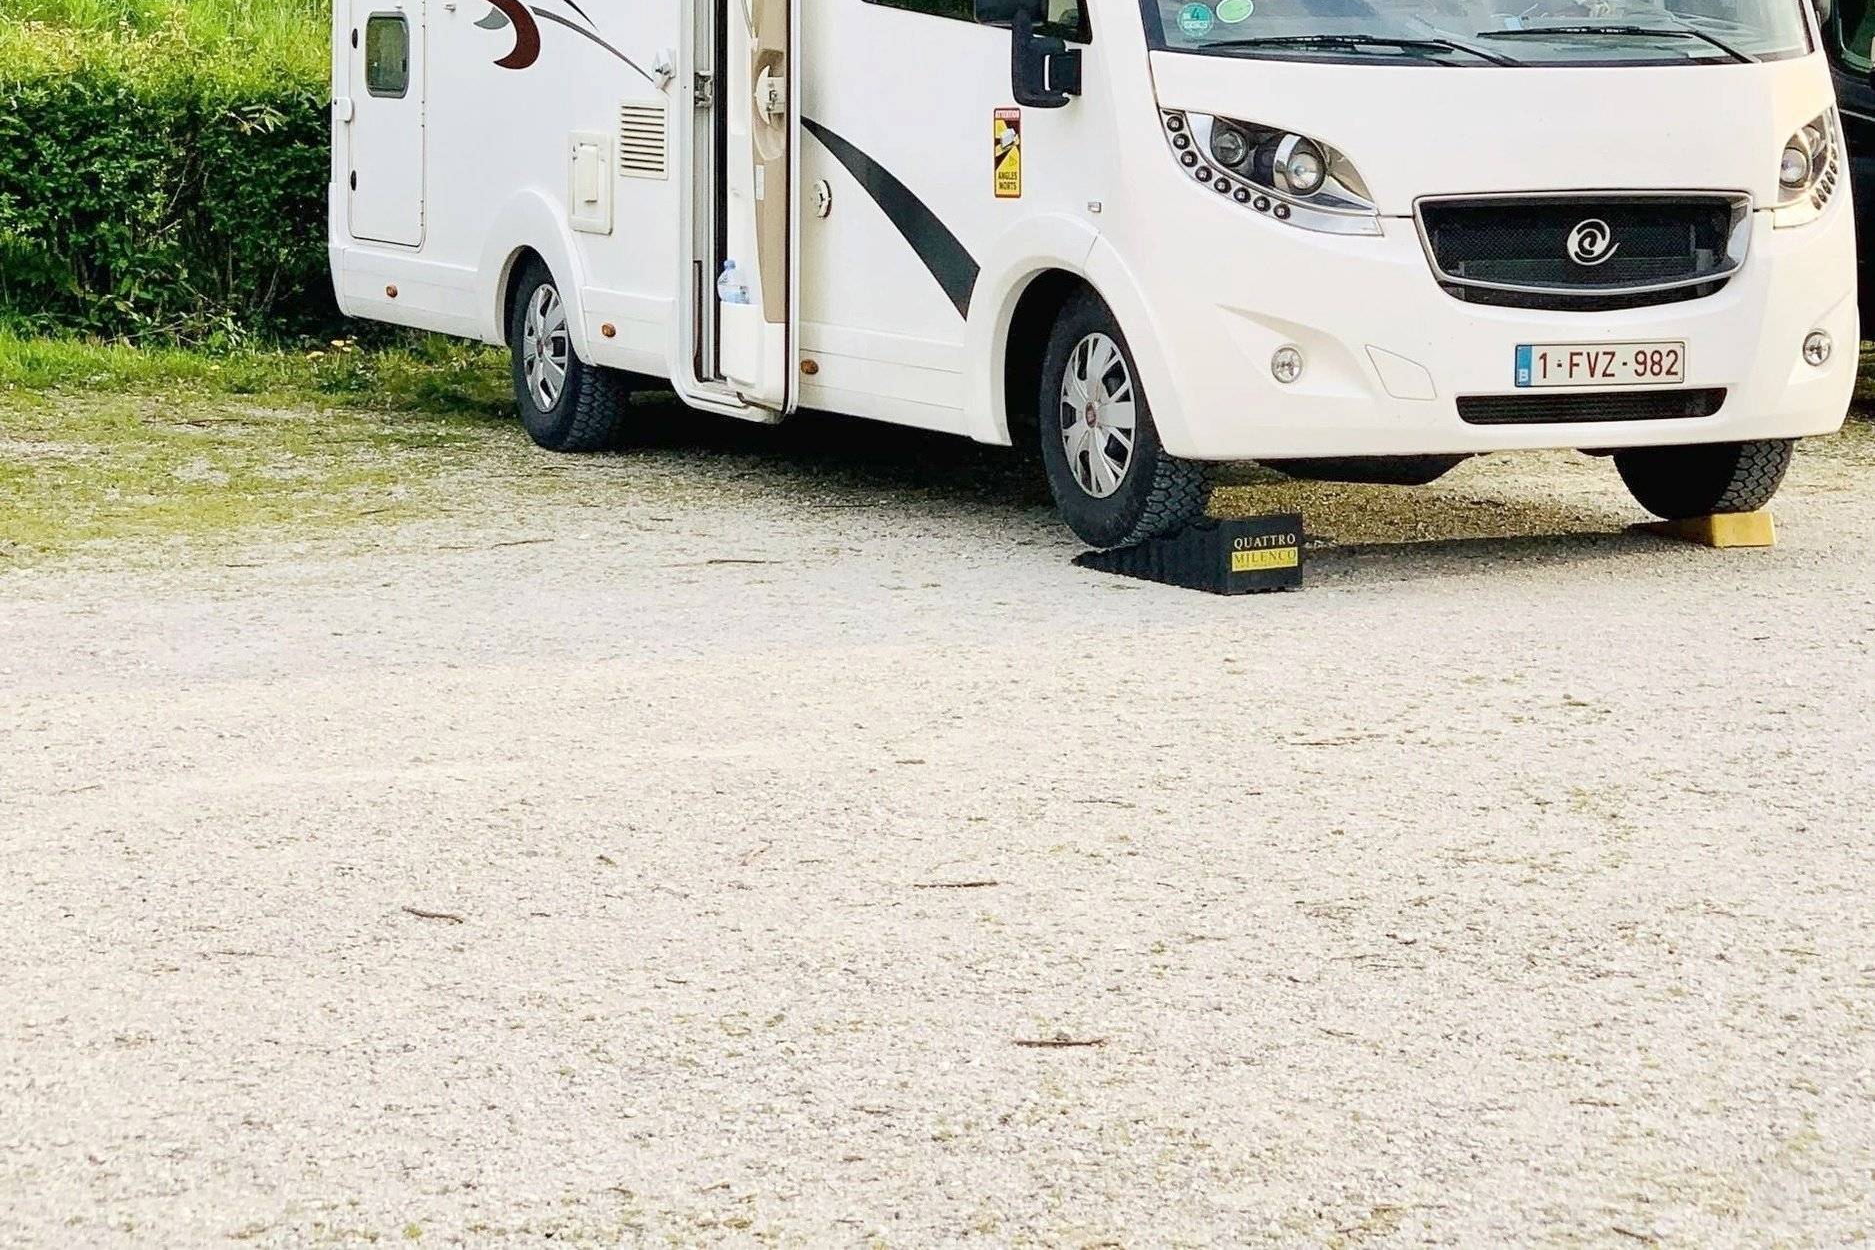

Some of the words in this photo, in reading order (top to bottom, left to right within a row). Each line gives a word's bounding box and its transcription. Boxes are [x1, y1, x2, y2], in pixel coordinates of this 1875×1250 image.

[1191, 7, 1200, 21] 4
[1518, 369, 1529, 383] B
[1233, 532, 1297, 550] QUATTRO
